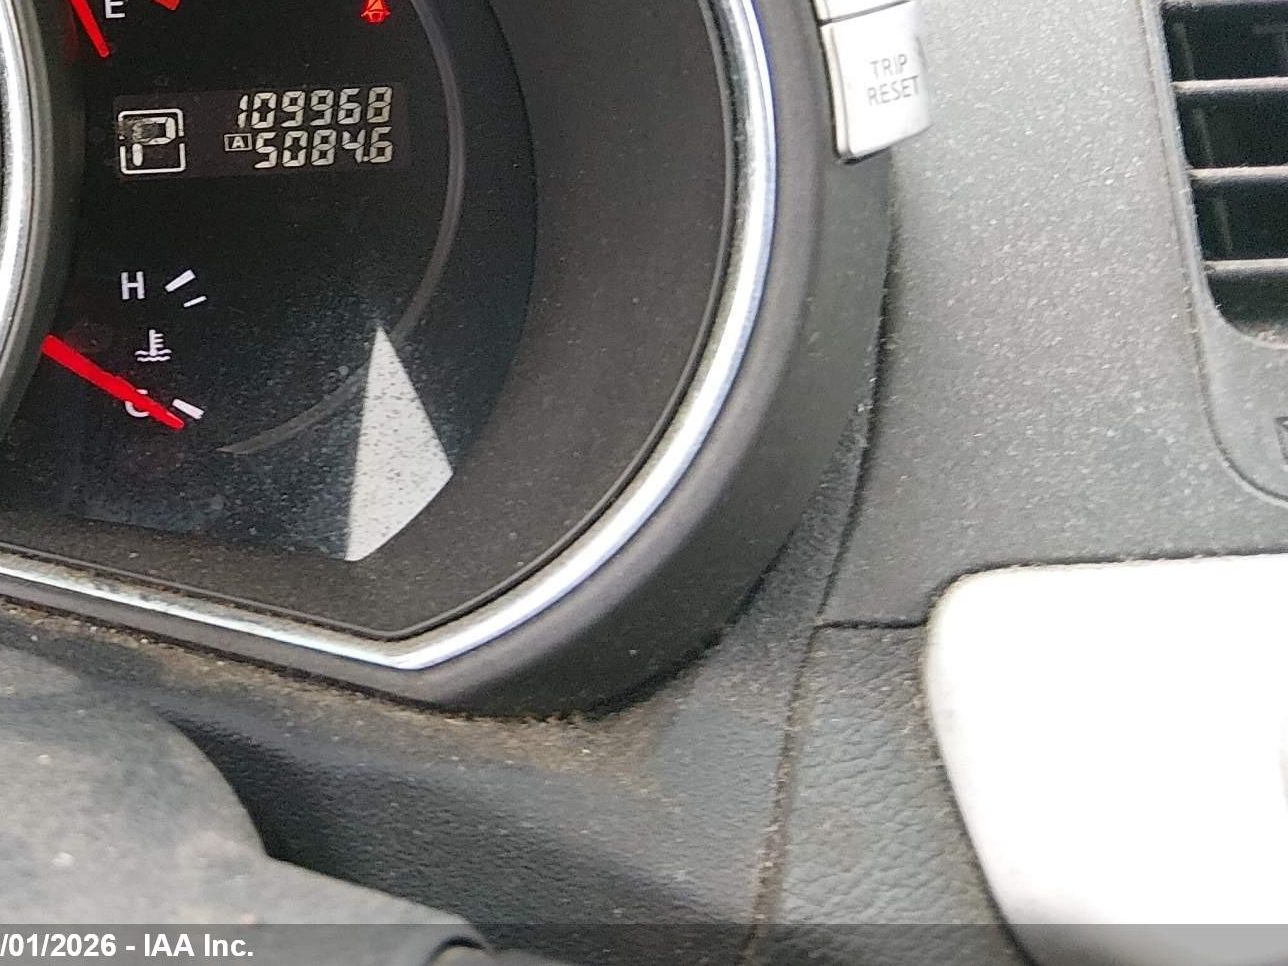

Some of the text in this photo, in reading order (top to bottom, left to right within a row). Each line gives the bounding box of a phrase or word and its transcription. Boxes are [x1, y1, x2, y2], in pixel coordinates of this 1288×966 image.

[869, 53, 908, 79] TRIP
[867, 74, 919, 106] RESET
[237, 86, 393, 129] 109968
[120, 271, 146, 300] H
